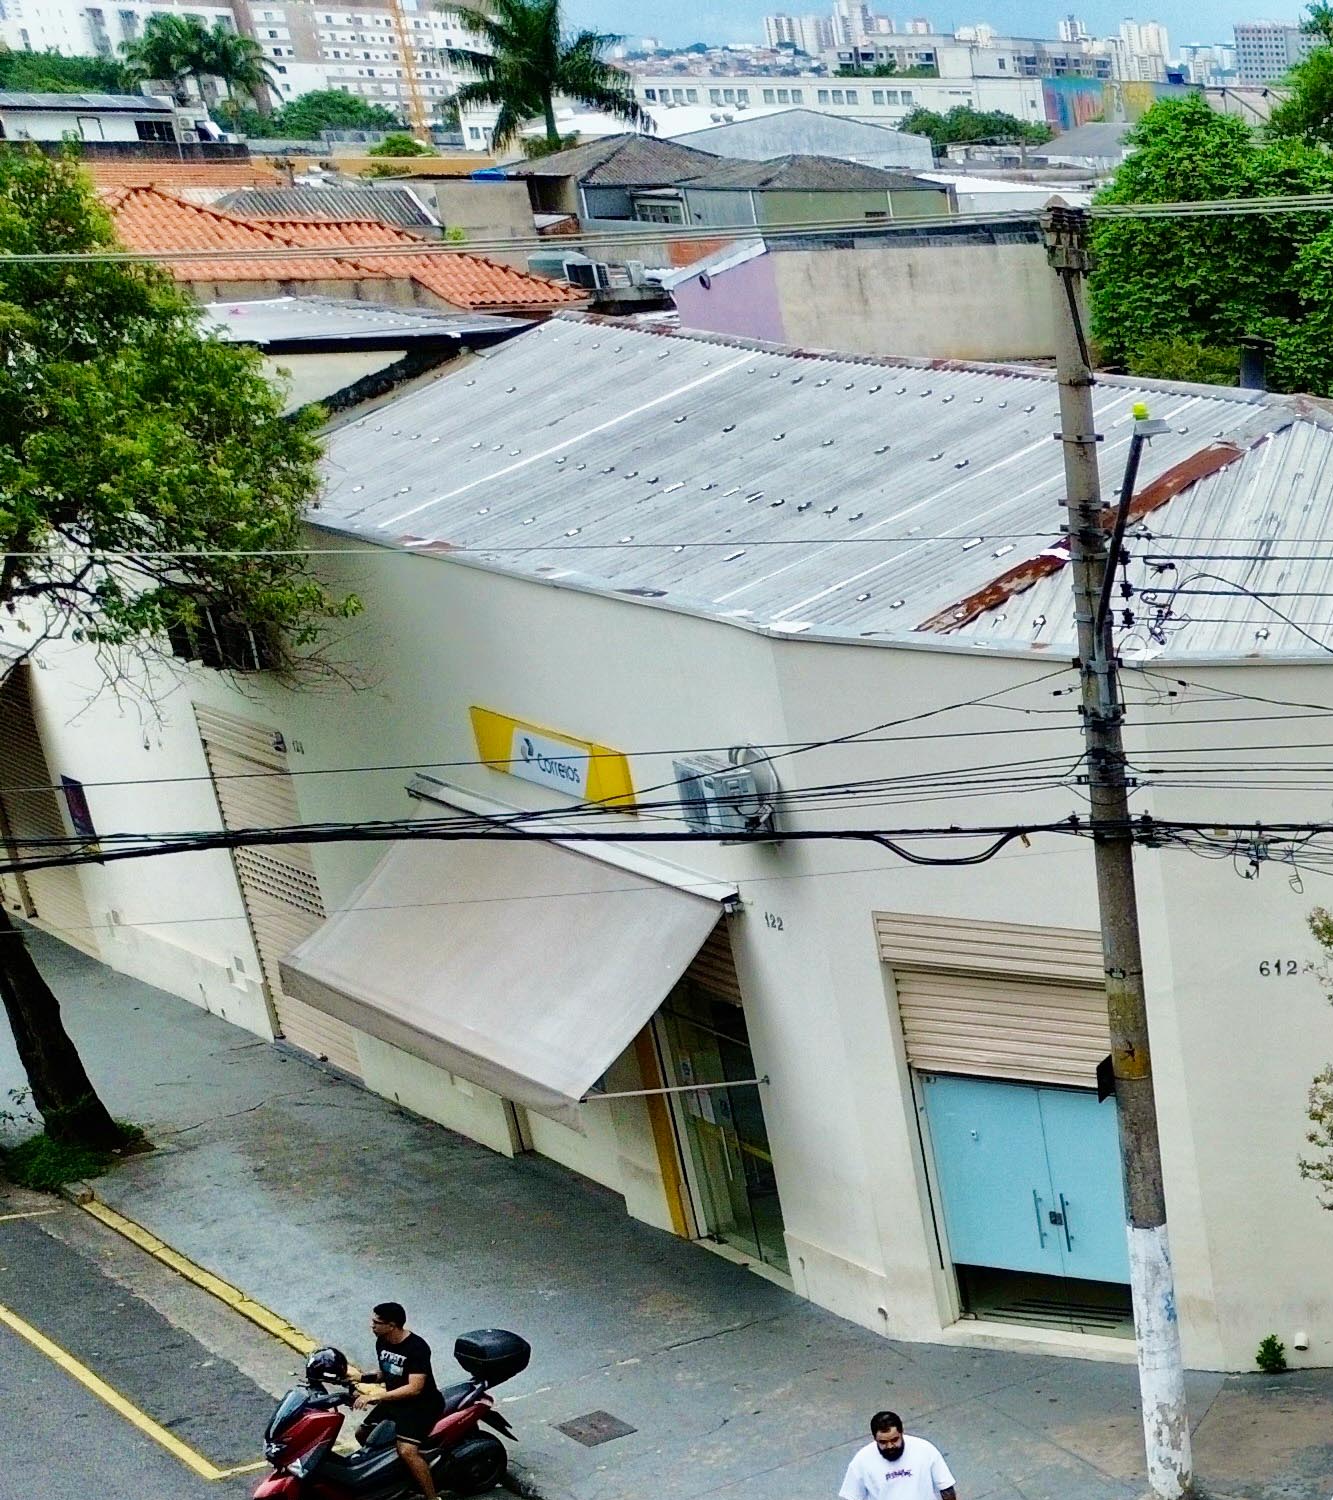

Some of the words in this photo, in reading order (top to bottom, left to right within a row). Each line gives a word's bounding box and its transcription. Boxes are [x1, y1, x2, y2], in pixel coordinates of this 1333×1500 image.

[537, 753, 581, 784] Correios
[764, 911, 784, 931] 122
[1259, 959, 1298, 977] 612
